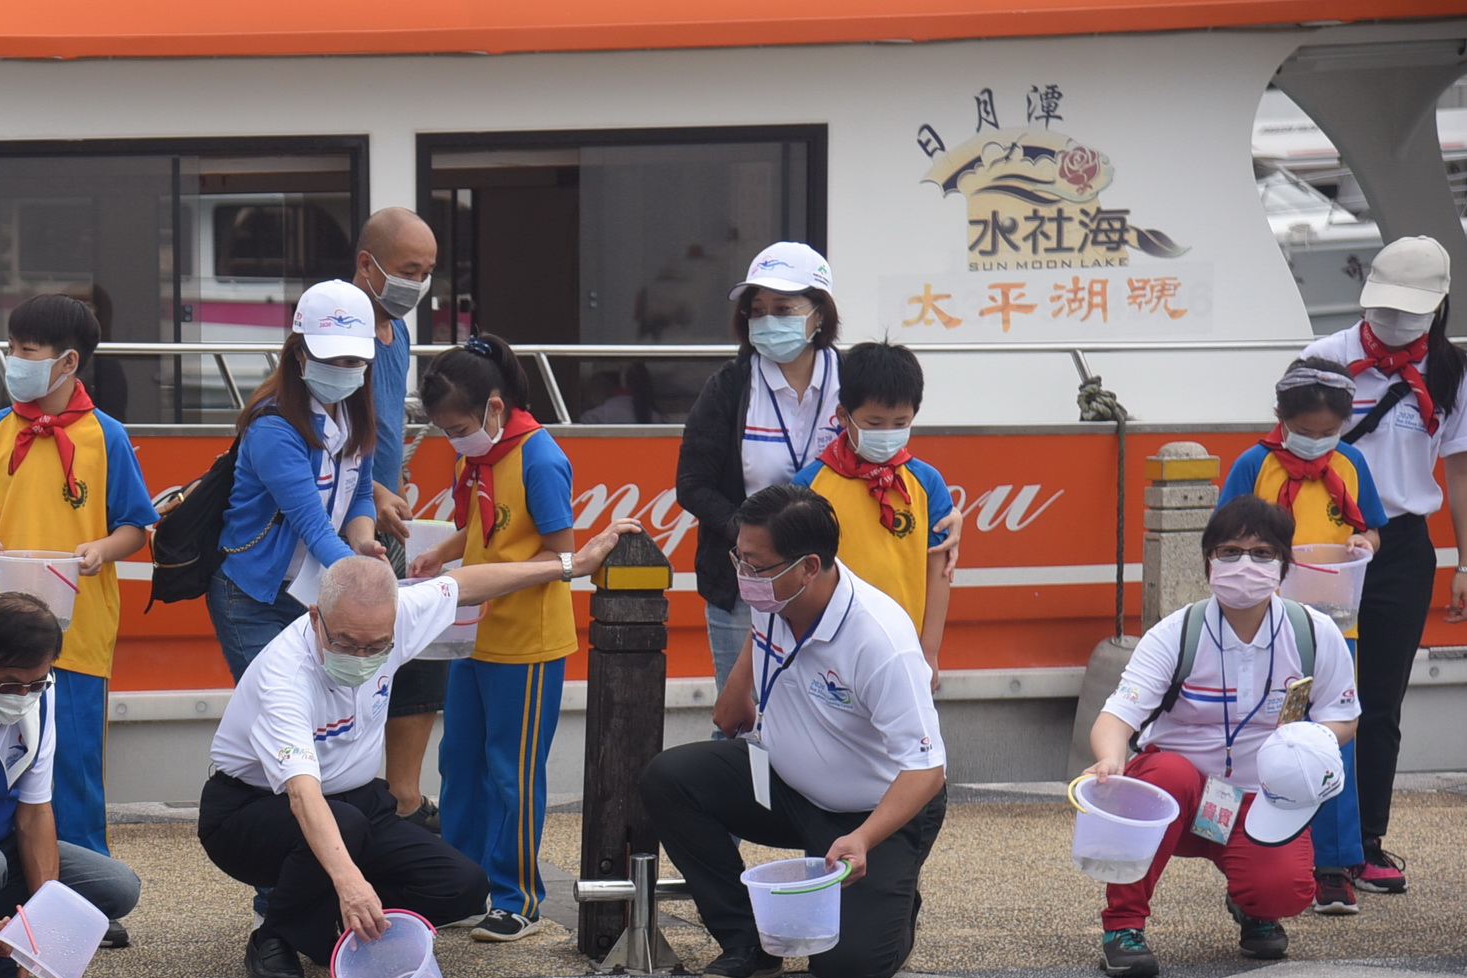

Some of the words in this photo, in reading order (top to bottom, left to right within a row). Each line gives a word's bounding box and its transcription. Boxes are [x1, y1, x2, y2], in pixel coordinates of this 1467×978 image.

[916, 84, 1064, 159] 日月潭
[967, 206, 1131, 257] 水社海
[968, 261, 1008, 272] SUN
[1015, 258, 1072, 271] MOON
[1079, 256, 1130, 269] LAKE
[901, 275, 1189, 334] 太平湖號
[1397, 411, 1415, 420] 2020
[1200, 800, 1233, 828] 貴賓
